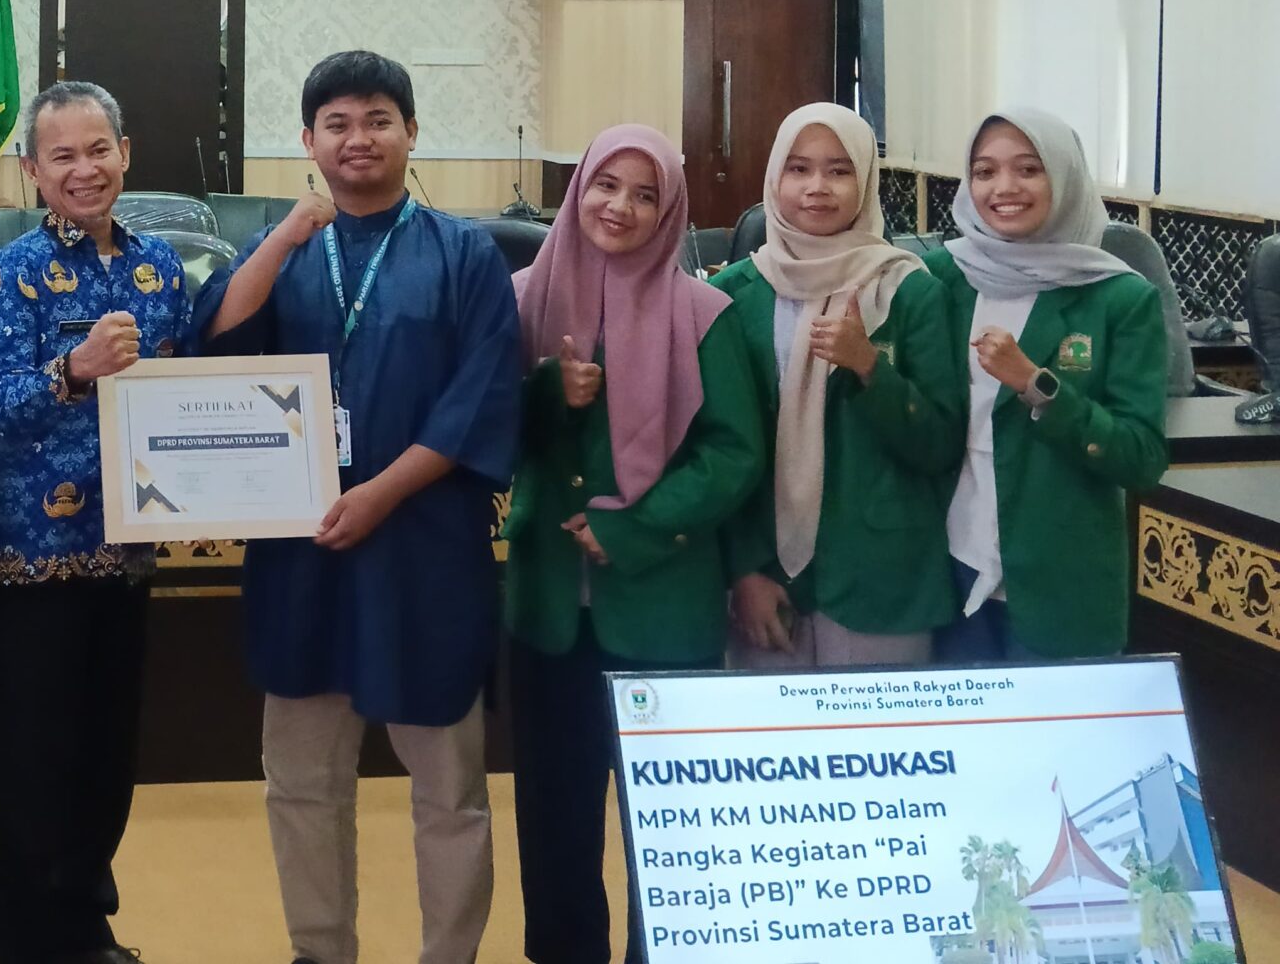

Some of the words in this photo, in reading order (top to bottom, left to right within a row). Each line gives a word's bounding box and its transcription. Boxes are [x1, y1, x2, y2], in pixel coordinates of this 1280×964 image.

[177, 400, 256, 414] SERTIFIKAT
[157, 438, 177, 447] DPRD
[177, 438, 213, 447] PROVINSI
[213, 436, 254, 446] SUMATERA
[255, 435, 280, 445] BARAT
[779, 684, 826, 697] Dewan
[831, 681, 909, 695] Perwakilan
[914, 680, 961, 694] Rakyat
[966, 678, 1014, 691] Daerah
[817, 698, 872, 711] Provinsi
[876, 695, 944, 709] Sumatera
[947, 694, 984, 706] Barat
[631, 756, 822, 786] KUNJUNGAN
[827, 750, 956, 778] EDUKASI
[637, 807, 701, 829] MPM
[710, 806, 751, 827] KM
[760, 802, 856, 825] UNAND
[865, 798, 947, 821] Dalam
[642, 844, 742, 871] Rangka
[751, 839, 867, 868] Kegiatan
[875, 834, 927, 857] “Pai
[647, 882, 731, 910] Baraja
[816, 879, 848, 899] Ke
[857, 874, 931, 897] DPRD
[652, 920, 759, 947] Provinsi
[768, 916, 894, 941] Sumatera
[902, 910, 973, 934] Barat
